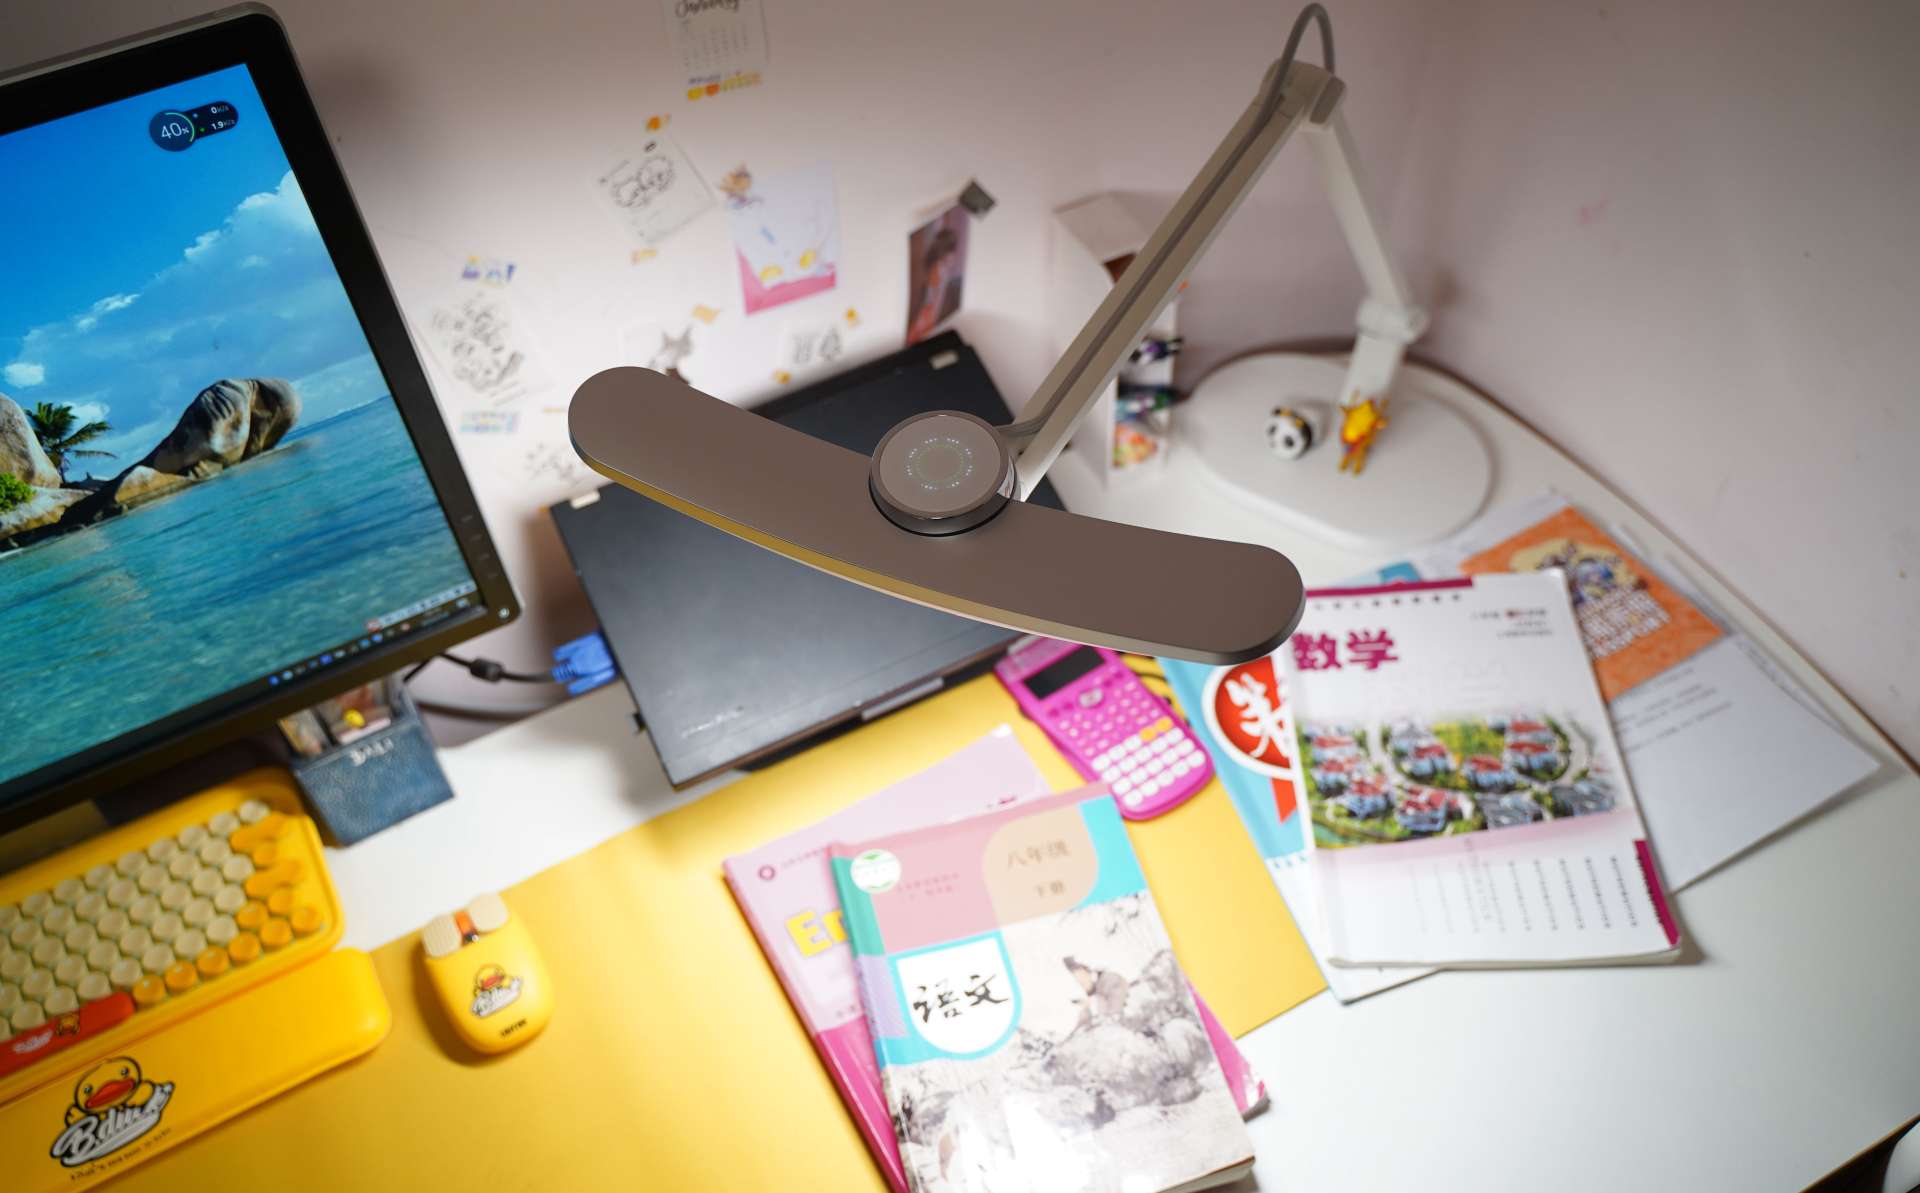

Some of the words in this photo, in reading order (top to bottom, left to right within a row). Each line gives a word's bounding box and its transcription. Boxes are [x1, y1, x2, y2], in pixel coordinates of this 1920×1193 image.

[161, 122, 190, 139] 40%
[1291, 629, 1398, 671] 数学
[912, 973, 1009, 1024] 语文
